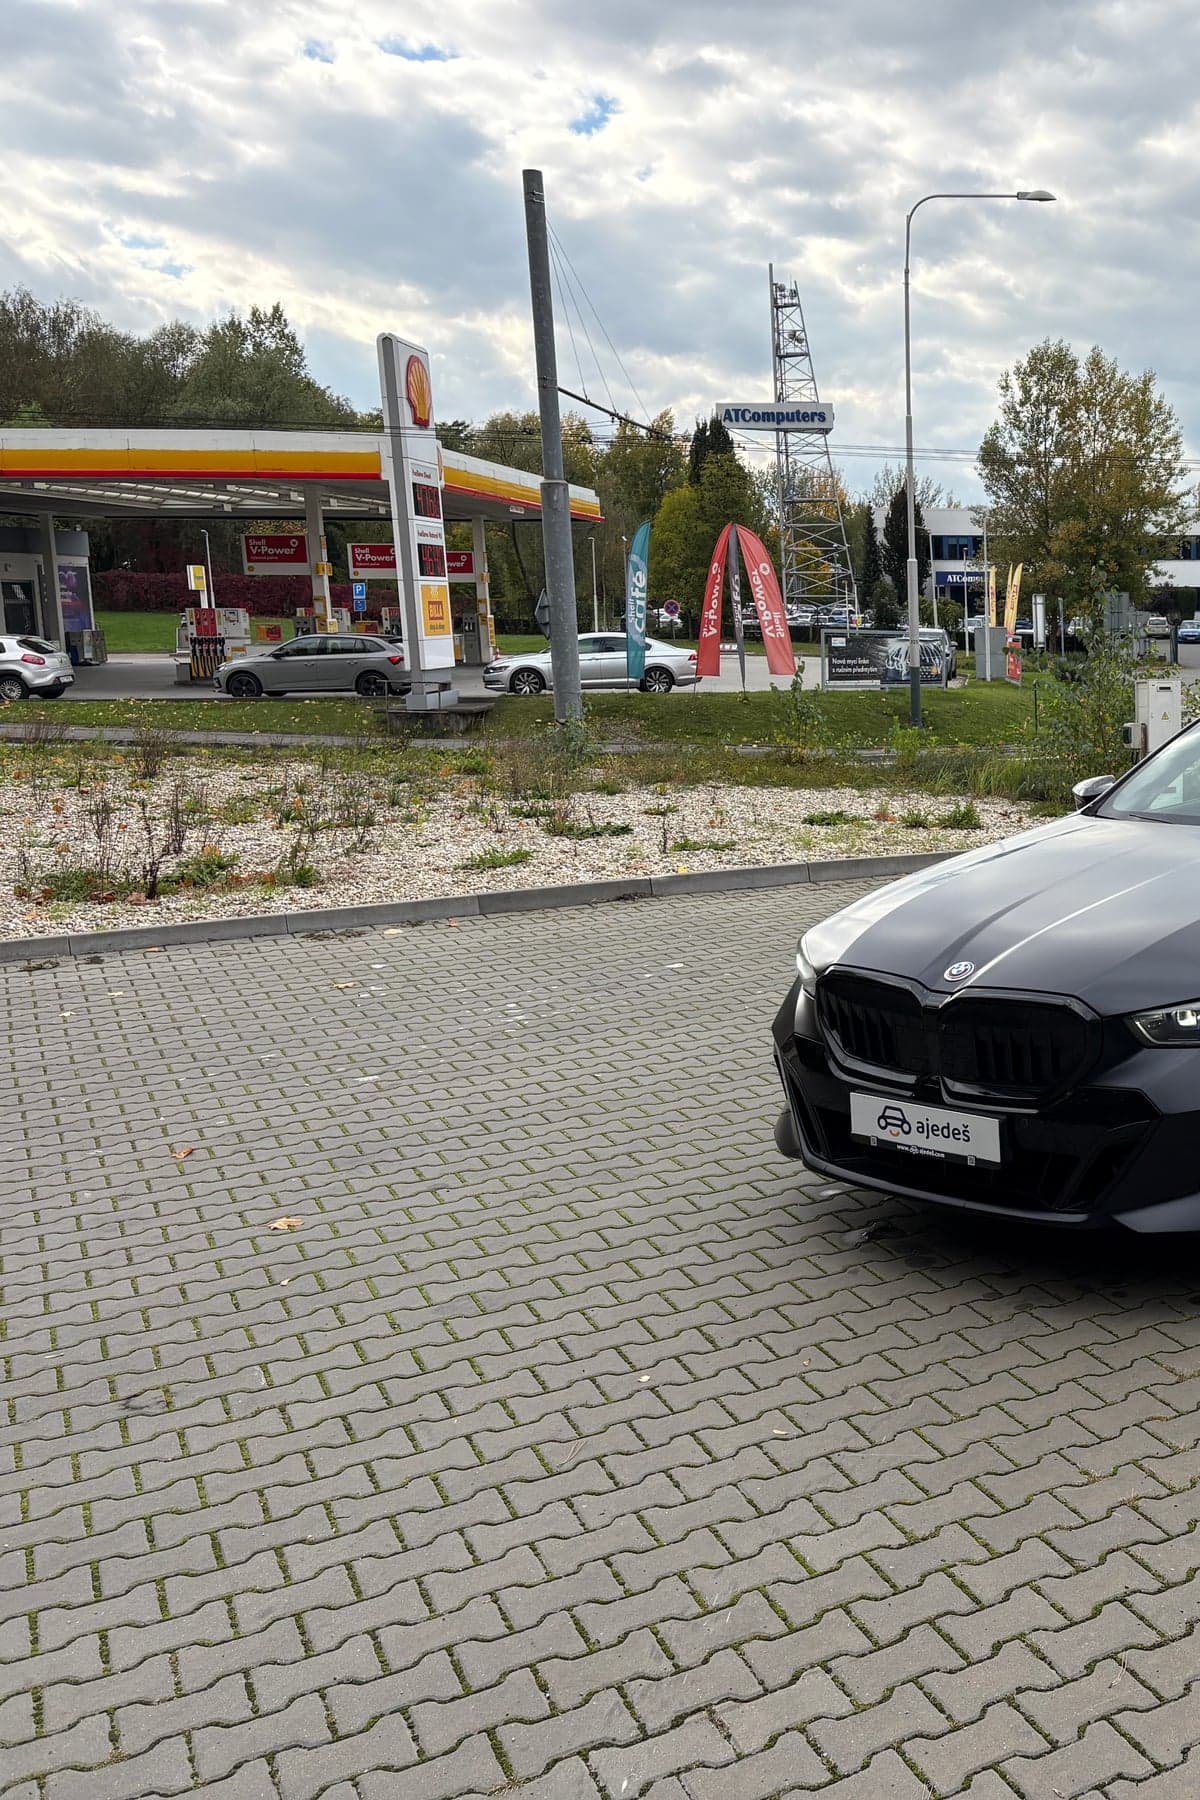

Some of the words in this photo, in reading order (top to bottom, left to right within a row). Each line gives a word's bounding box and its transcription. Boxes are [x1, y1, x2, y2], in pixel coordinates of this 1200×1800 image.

[723, 408, 826, 426] ATComputers
[249, 538, 267, 546] Shell
[250, 546, 296, 555] V-Power
[355, 553, 395, 562] V-Power
[356, 585, 362, 594] P
[631, 571, 647, 632] café
[628, 598, 636, 623] Shell
[832, 657, 846, 665] Nová
[916, 1118, 971, 1143] ajedeš
